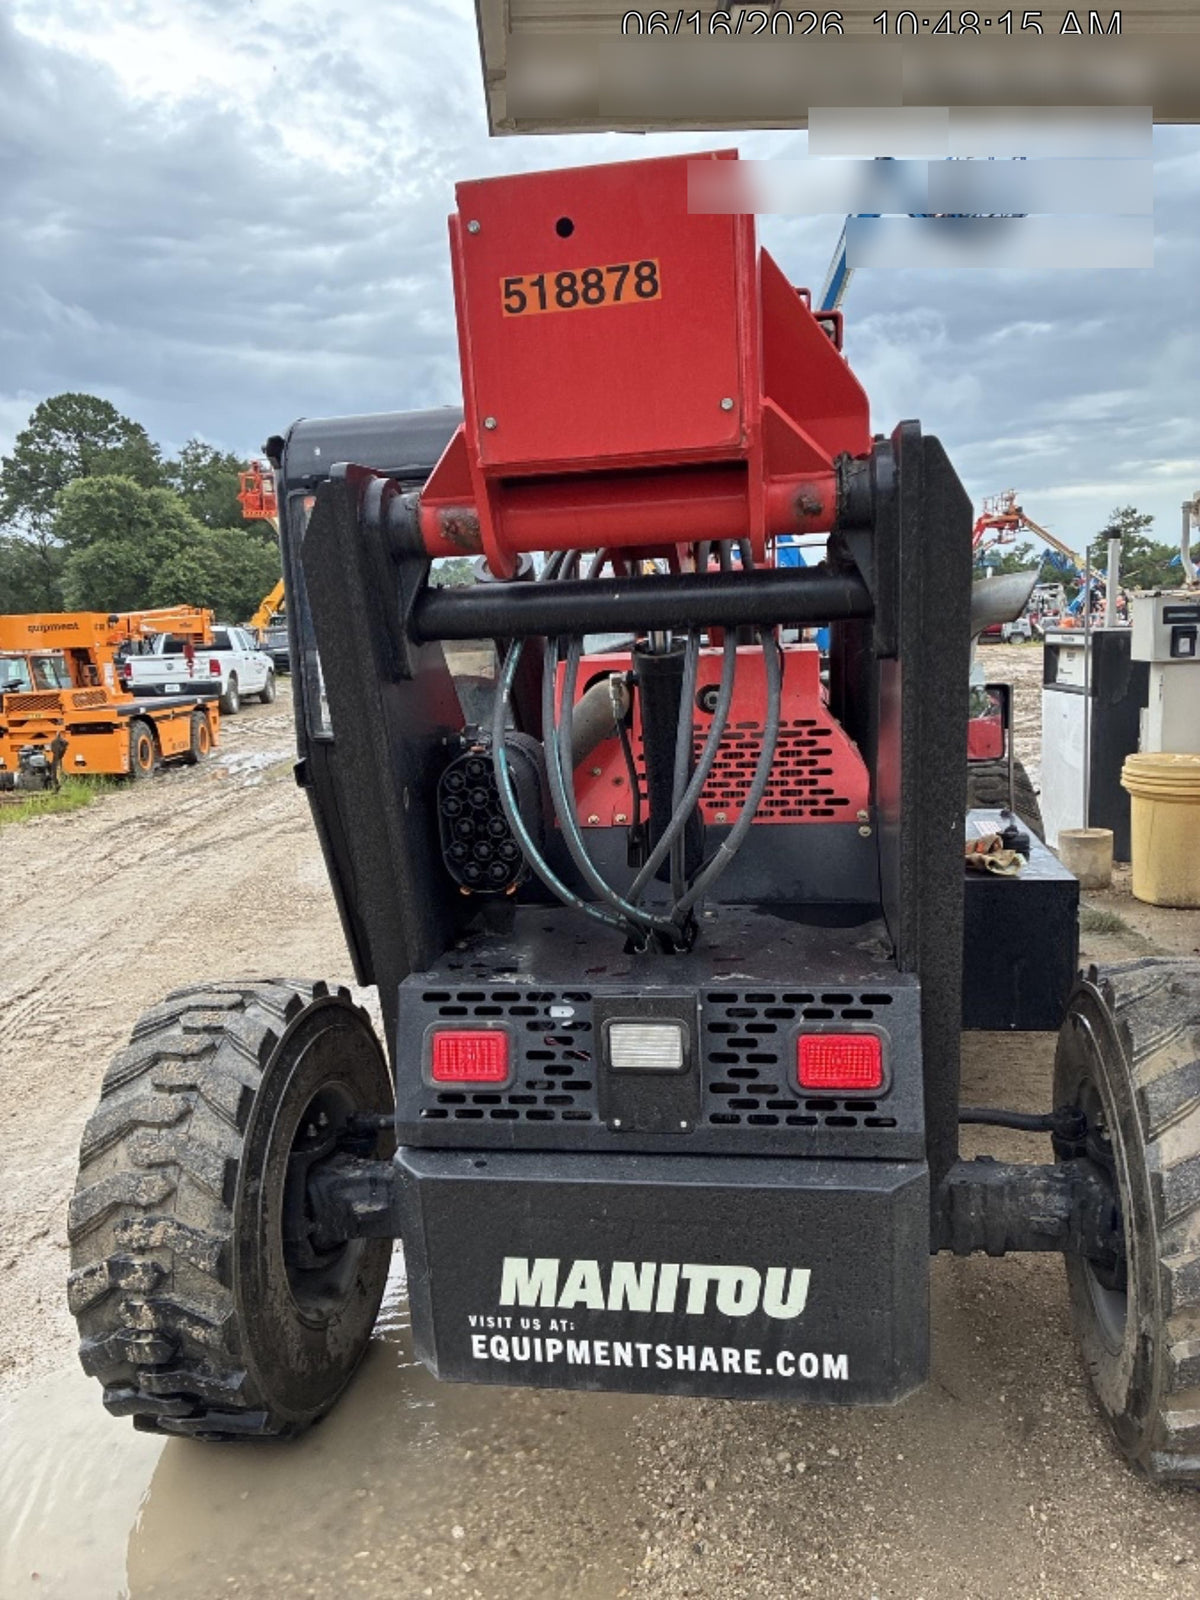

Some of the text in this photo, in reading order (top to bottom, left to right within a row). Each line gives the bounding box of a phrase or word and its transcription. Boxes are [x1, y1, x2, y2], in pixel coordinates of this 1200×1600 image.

[503, 259, 660, 314] 518878
[498, 1256, 812, 1320] MANITOU
[468, 1314, 576, 1332] VISIT US AT:
[470, 1334, 850, 1382] EQUIPMENTSHARE.COM
